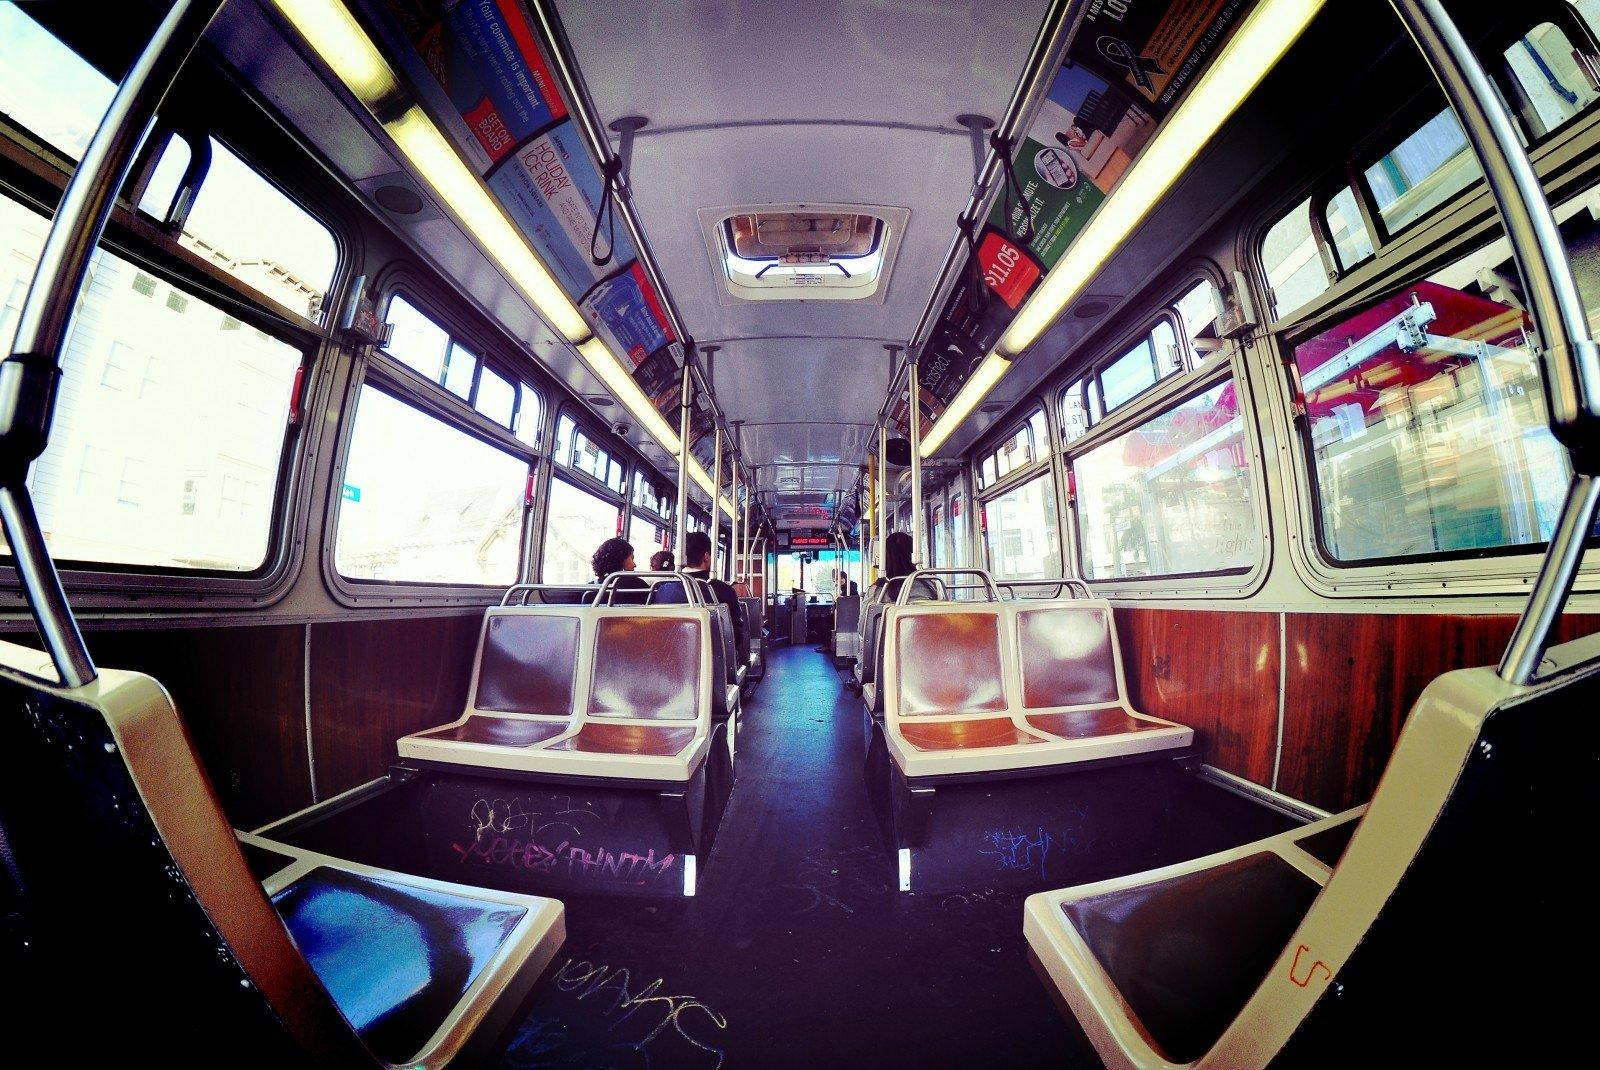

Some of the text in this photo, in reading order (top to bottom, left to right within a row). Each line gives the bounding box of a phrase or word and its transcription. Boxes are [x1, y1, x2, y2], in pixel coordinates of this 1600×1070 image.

[1102, 0, 1131, 21] LO
[478, 0, 540, 110] Your commute is important.
[499, 74, 516, 99] rolling
[519, 110, 530, 123] the
[478, 119, 502, 151] BOARD
[487, 112, 512, 144] GET ON
[522, 150, 559, 200] ICE RINK
[535, 142, 571, 190] HOLIDAY
[1011, 207, 1023, 221] YOUR
[1016, 204, 1041, 237] PERSONLIZE
[1035, 197, 1045, 206] IT.
[985, 243, 1020, 287] $11.05
[919, 352, 951, 391] Satisfied.
